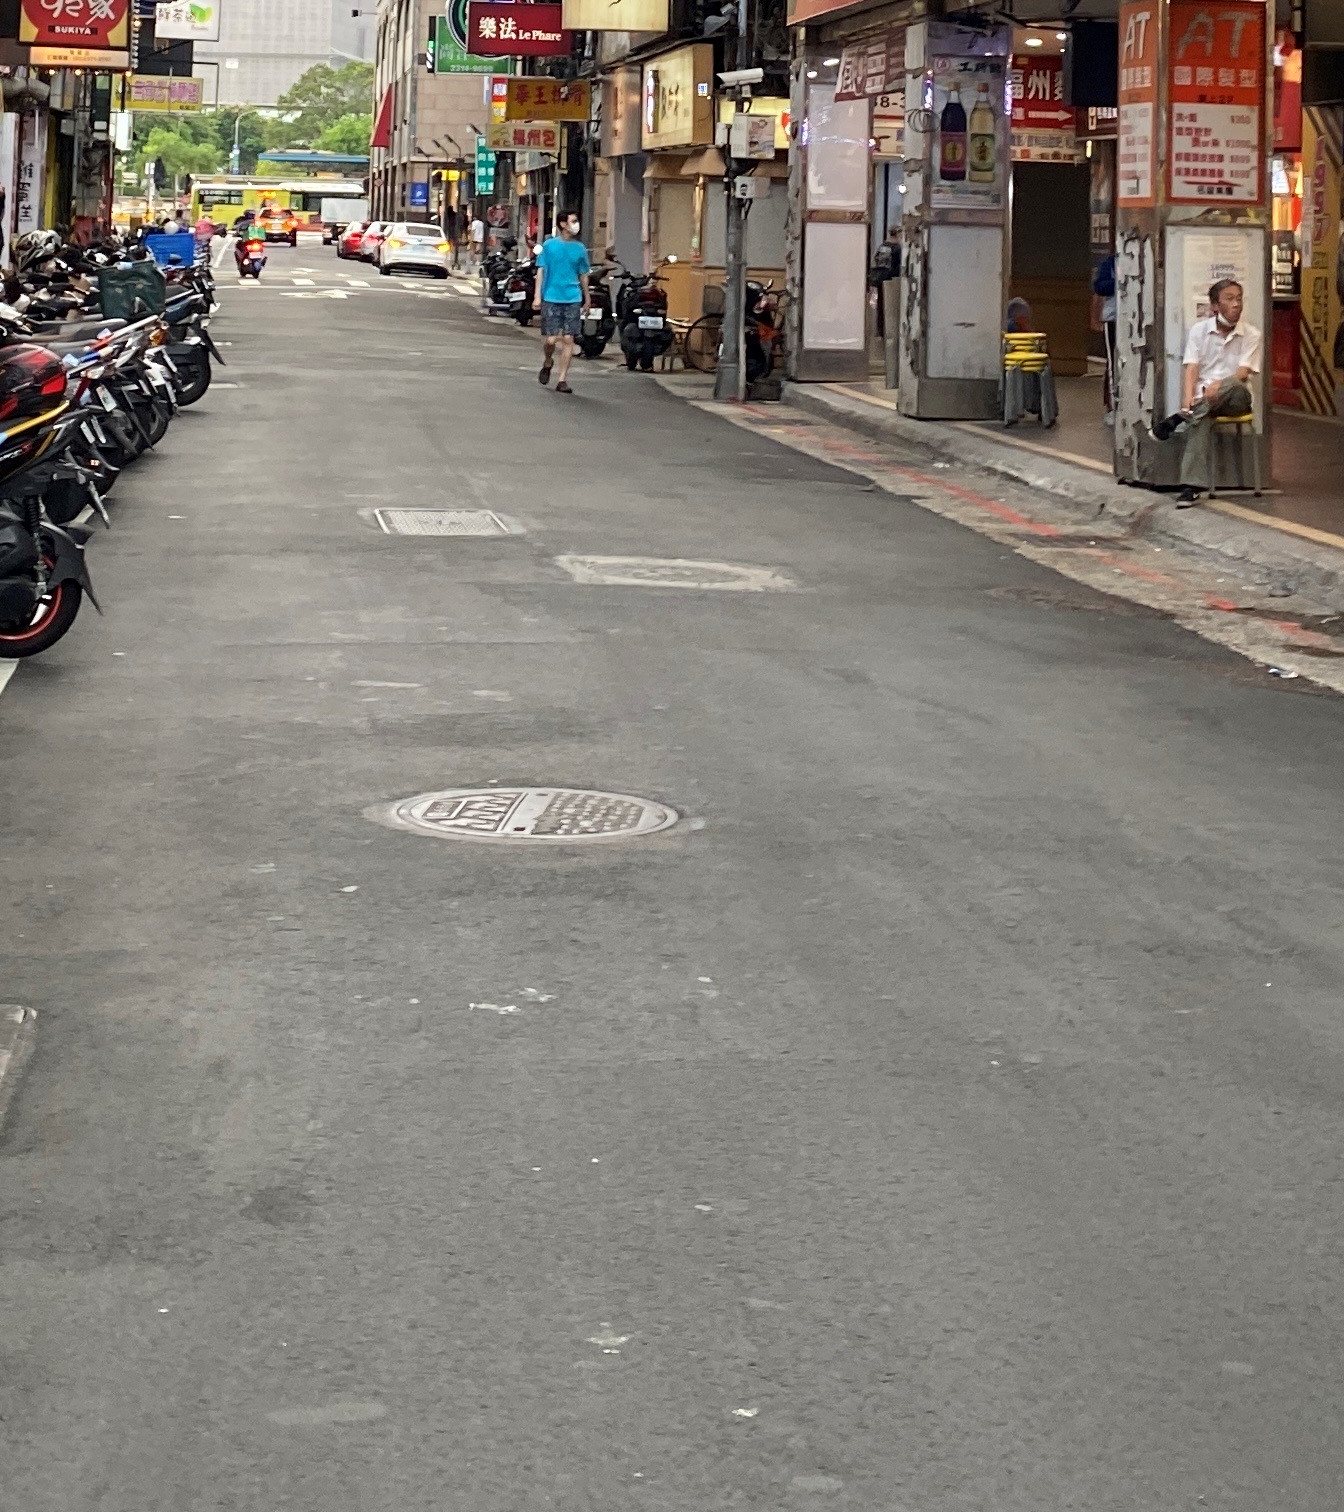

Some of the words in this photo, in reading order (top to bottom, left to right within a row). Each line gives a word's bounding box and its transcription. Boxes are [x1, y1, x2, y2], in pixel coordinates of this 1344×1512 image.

[54, 26, 92, 35] SUKIYA
[478, 16, 517, 40] 樂法
[518, 29, 531, 40] Le
[531, 29, 562, 42] Phare
[1121, 11, 1151, 64] AT
[1176, 10, 1260, 59] AT
